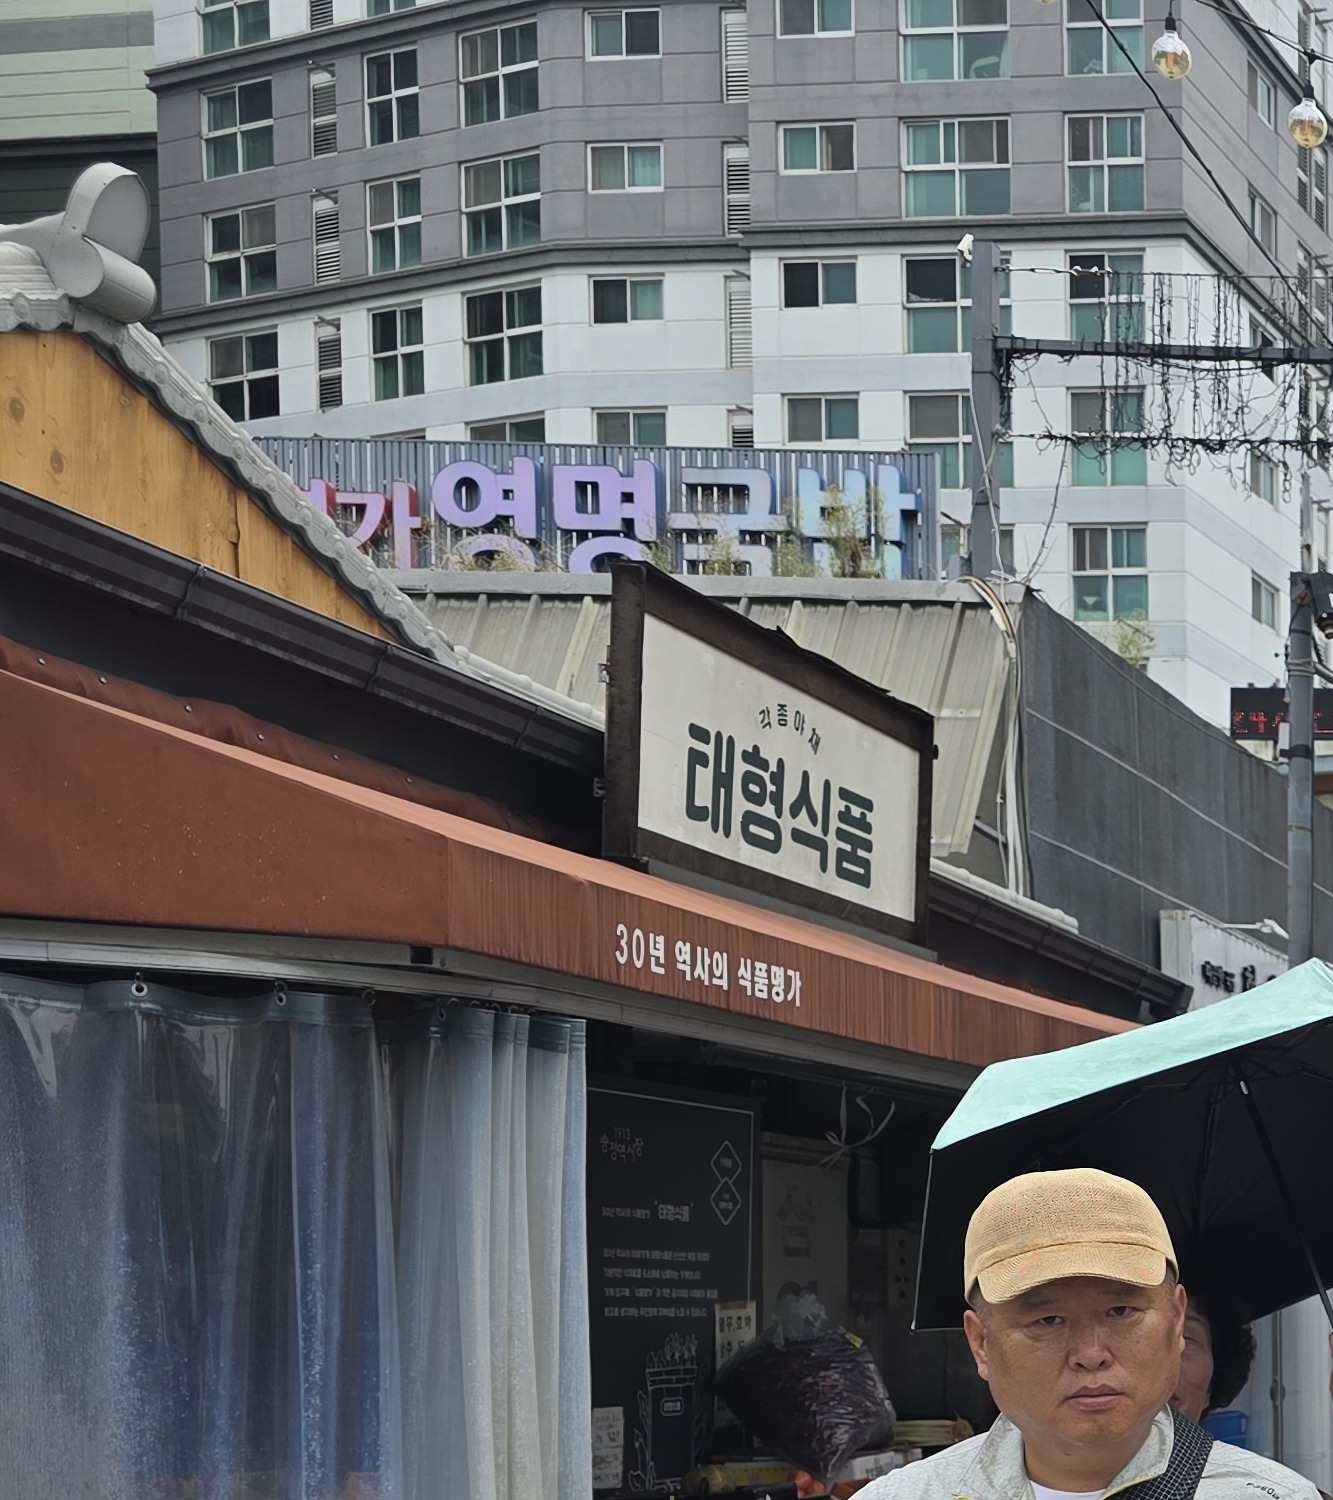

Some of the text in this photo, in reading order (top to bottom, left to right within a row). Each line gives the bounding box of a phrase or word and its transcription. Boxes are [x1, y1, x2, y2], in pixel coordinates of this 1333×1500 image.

[758, 703, 822, 755] 각종야채
[685, 722, 875, 889] 태형식품
[614, 923, 802, 1007] 30년 역사의 식품명가
